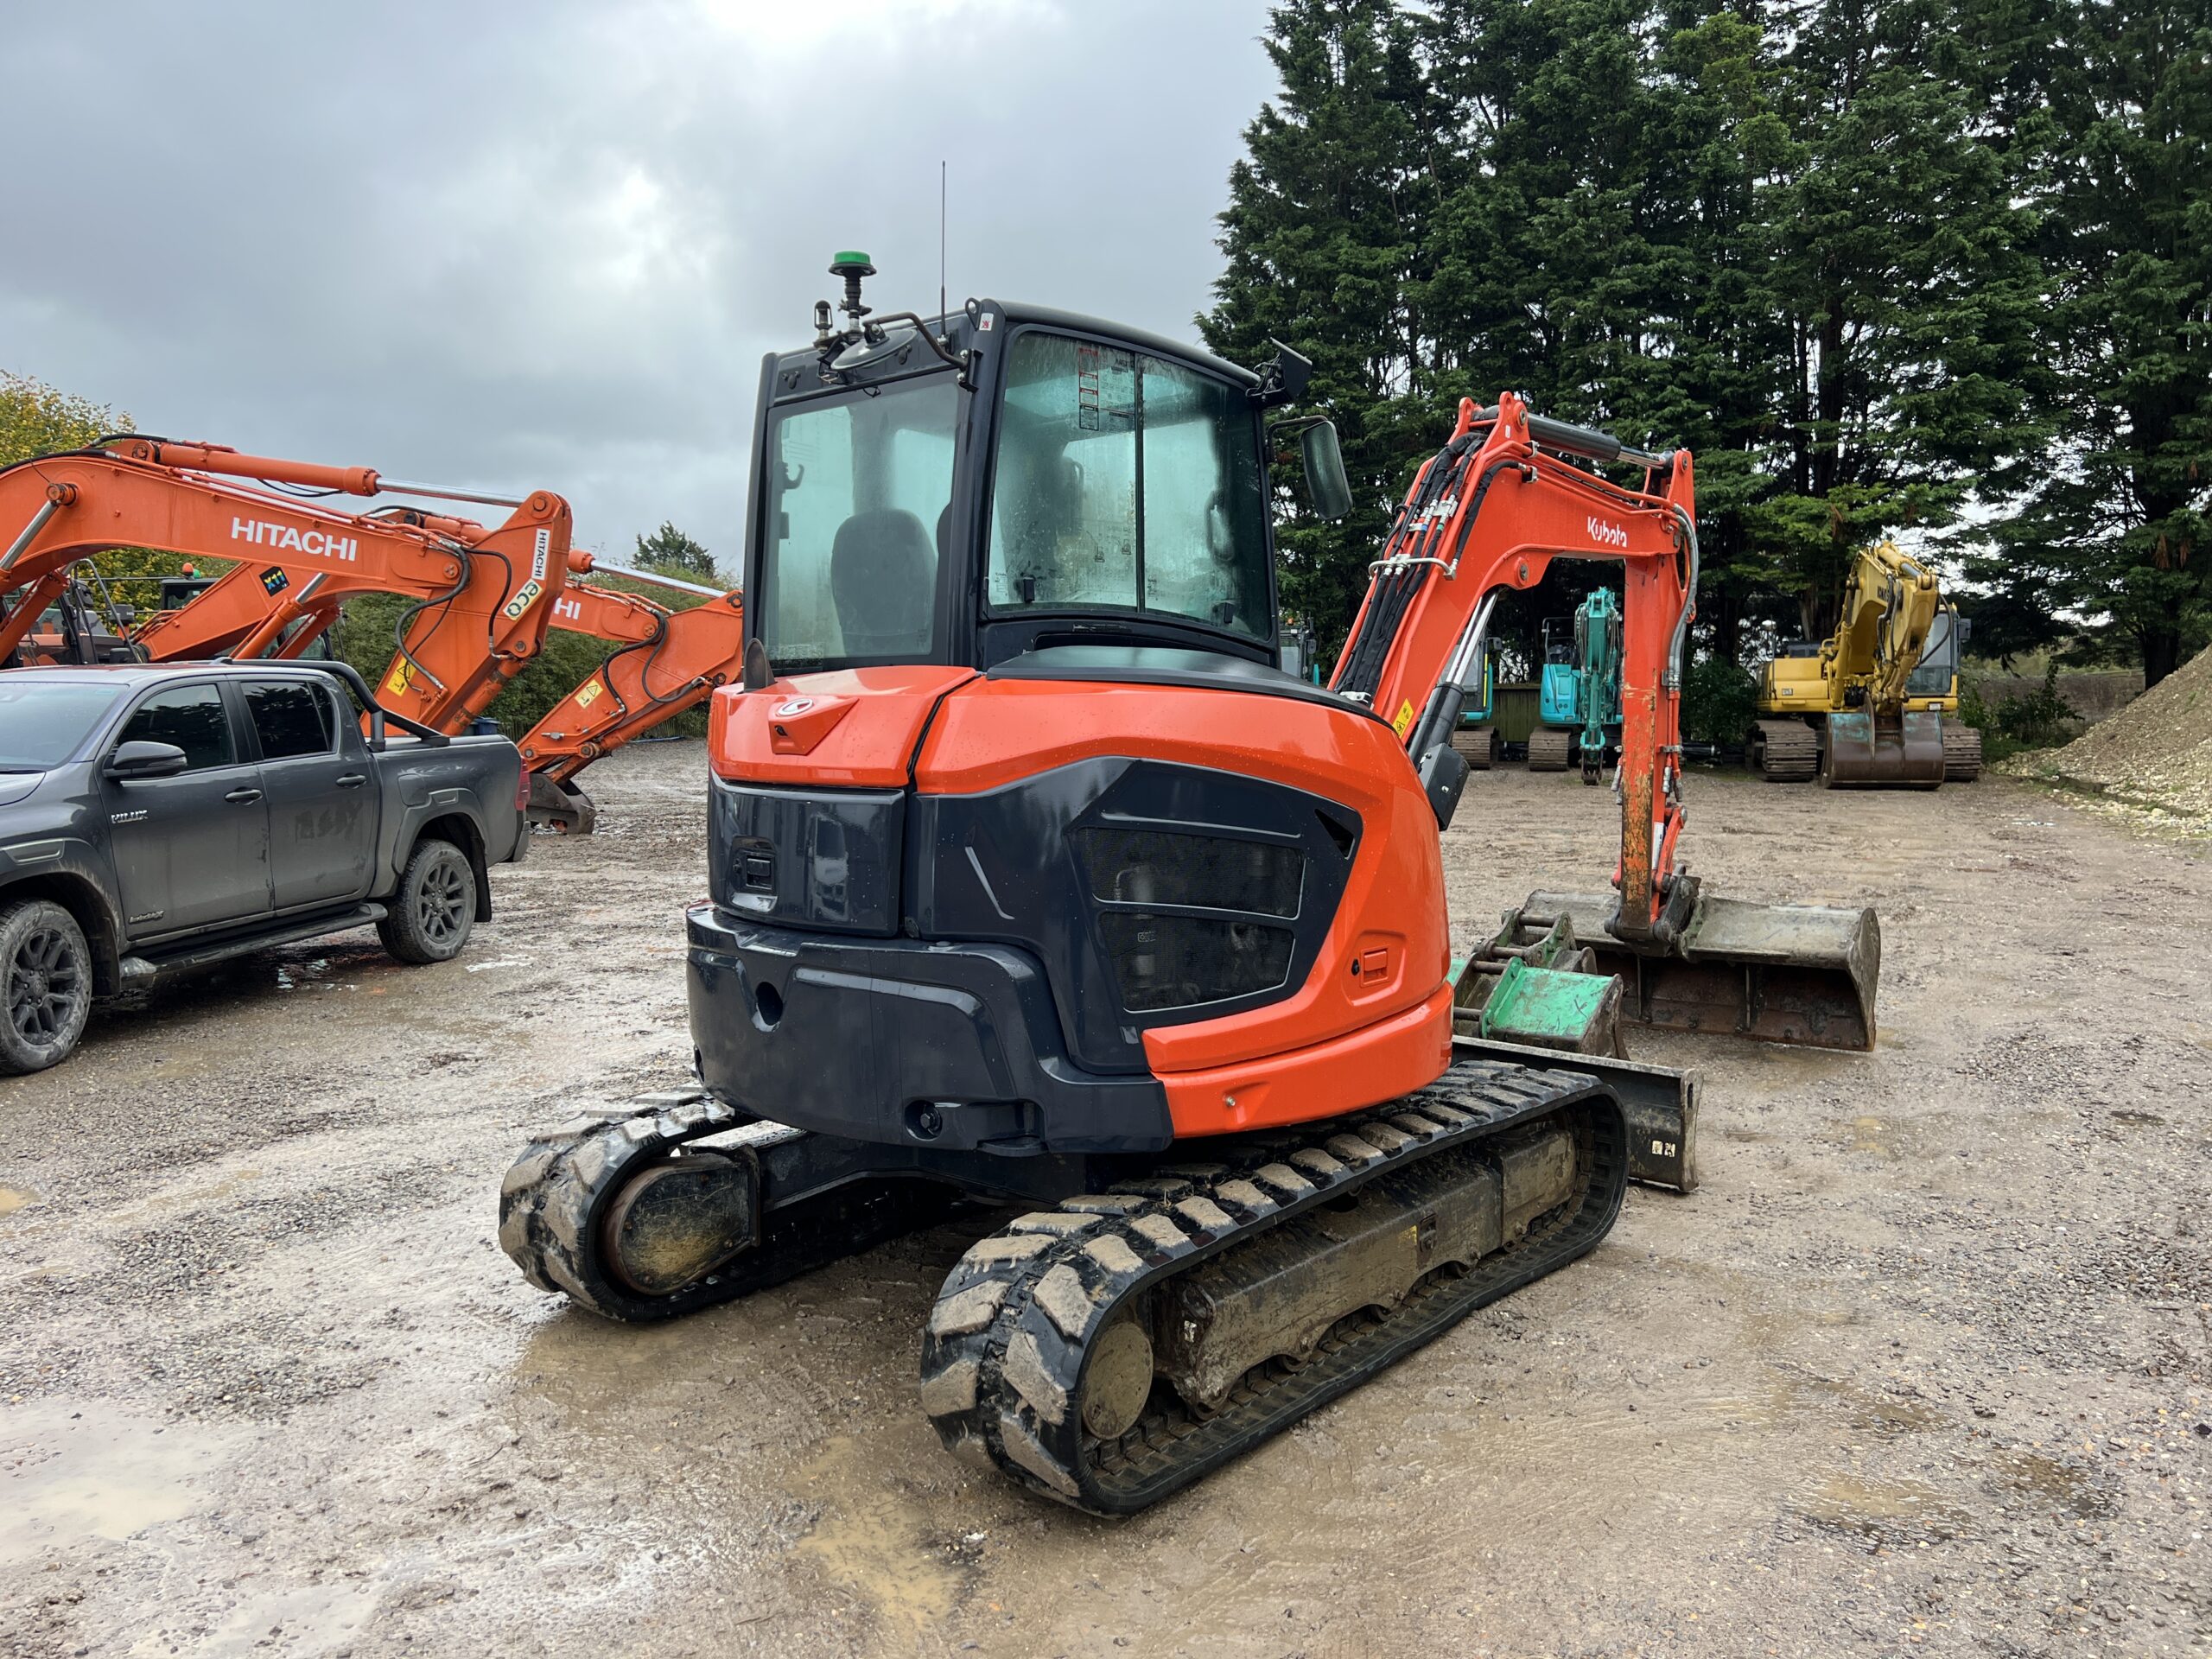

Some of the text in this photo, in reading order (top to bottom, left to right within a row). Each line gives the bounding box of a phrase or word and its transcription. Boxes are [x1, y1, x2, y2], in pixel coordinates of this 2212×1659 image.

[232, 517, 357, 562] HITACHI
[534, 532, 547, 577] HITACHI
[1587, 516, 1627, 548] Kubota
